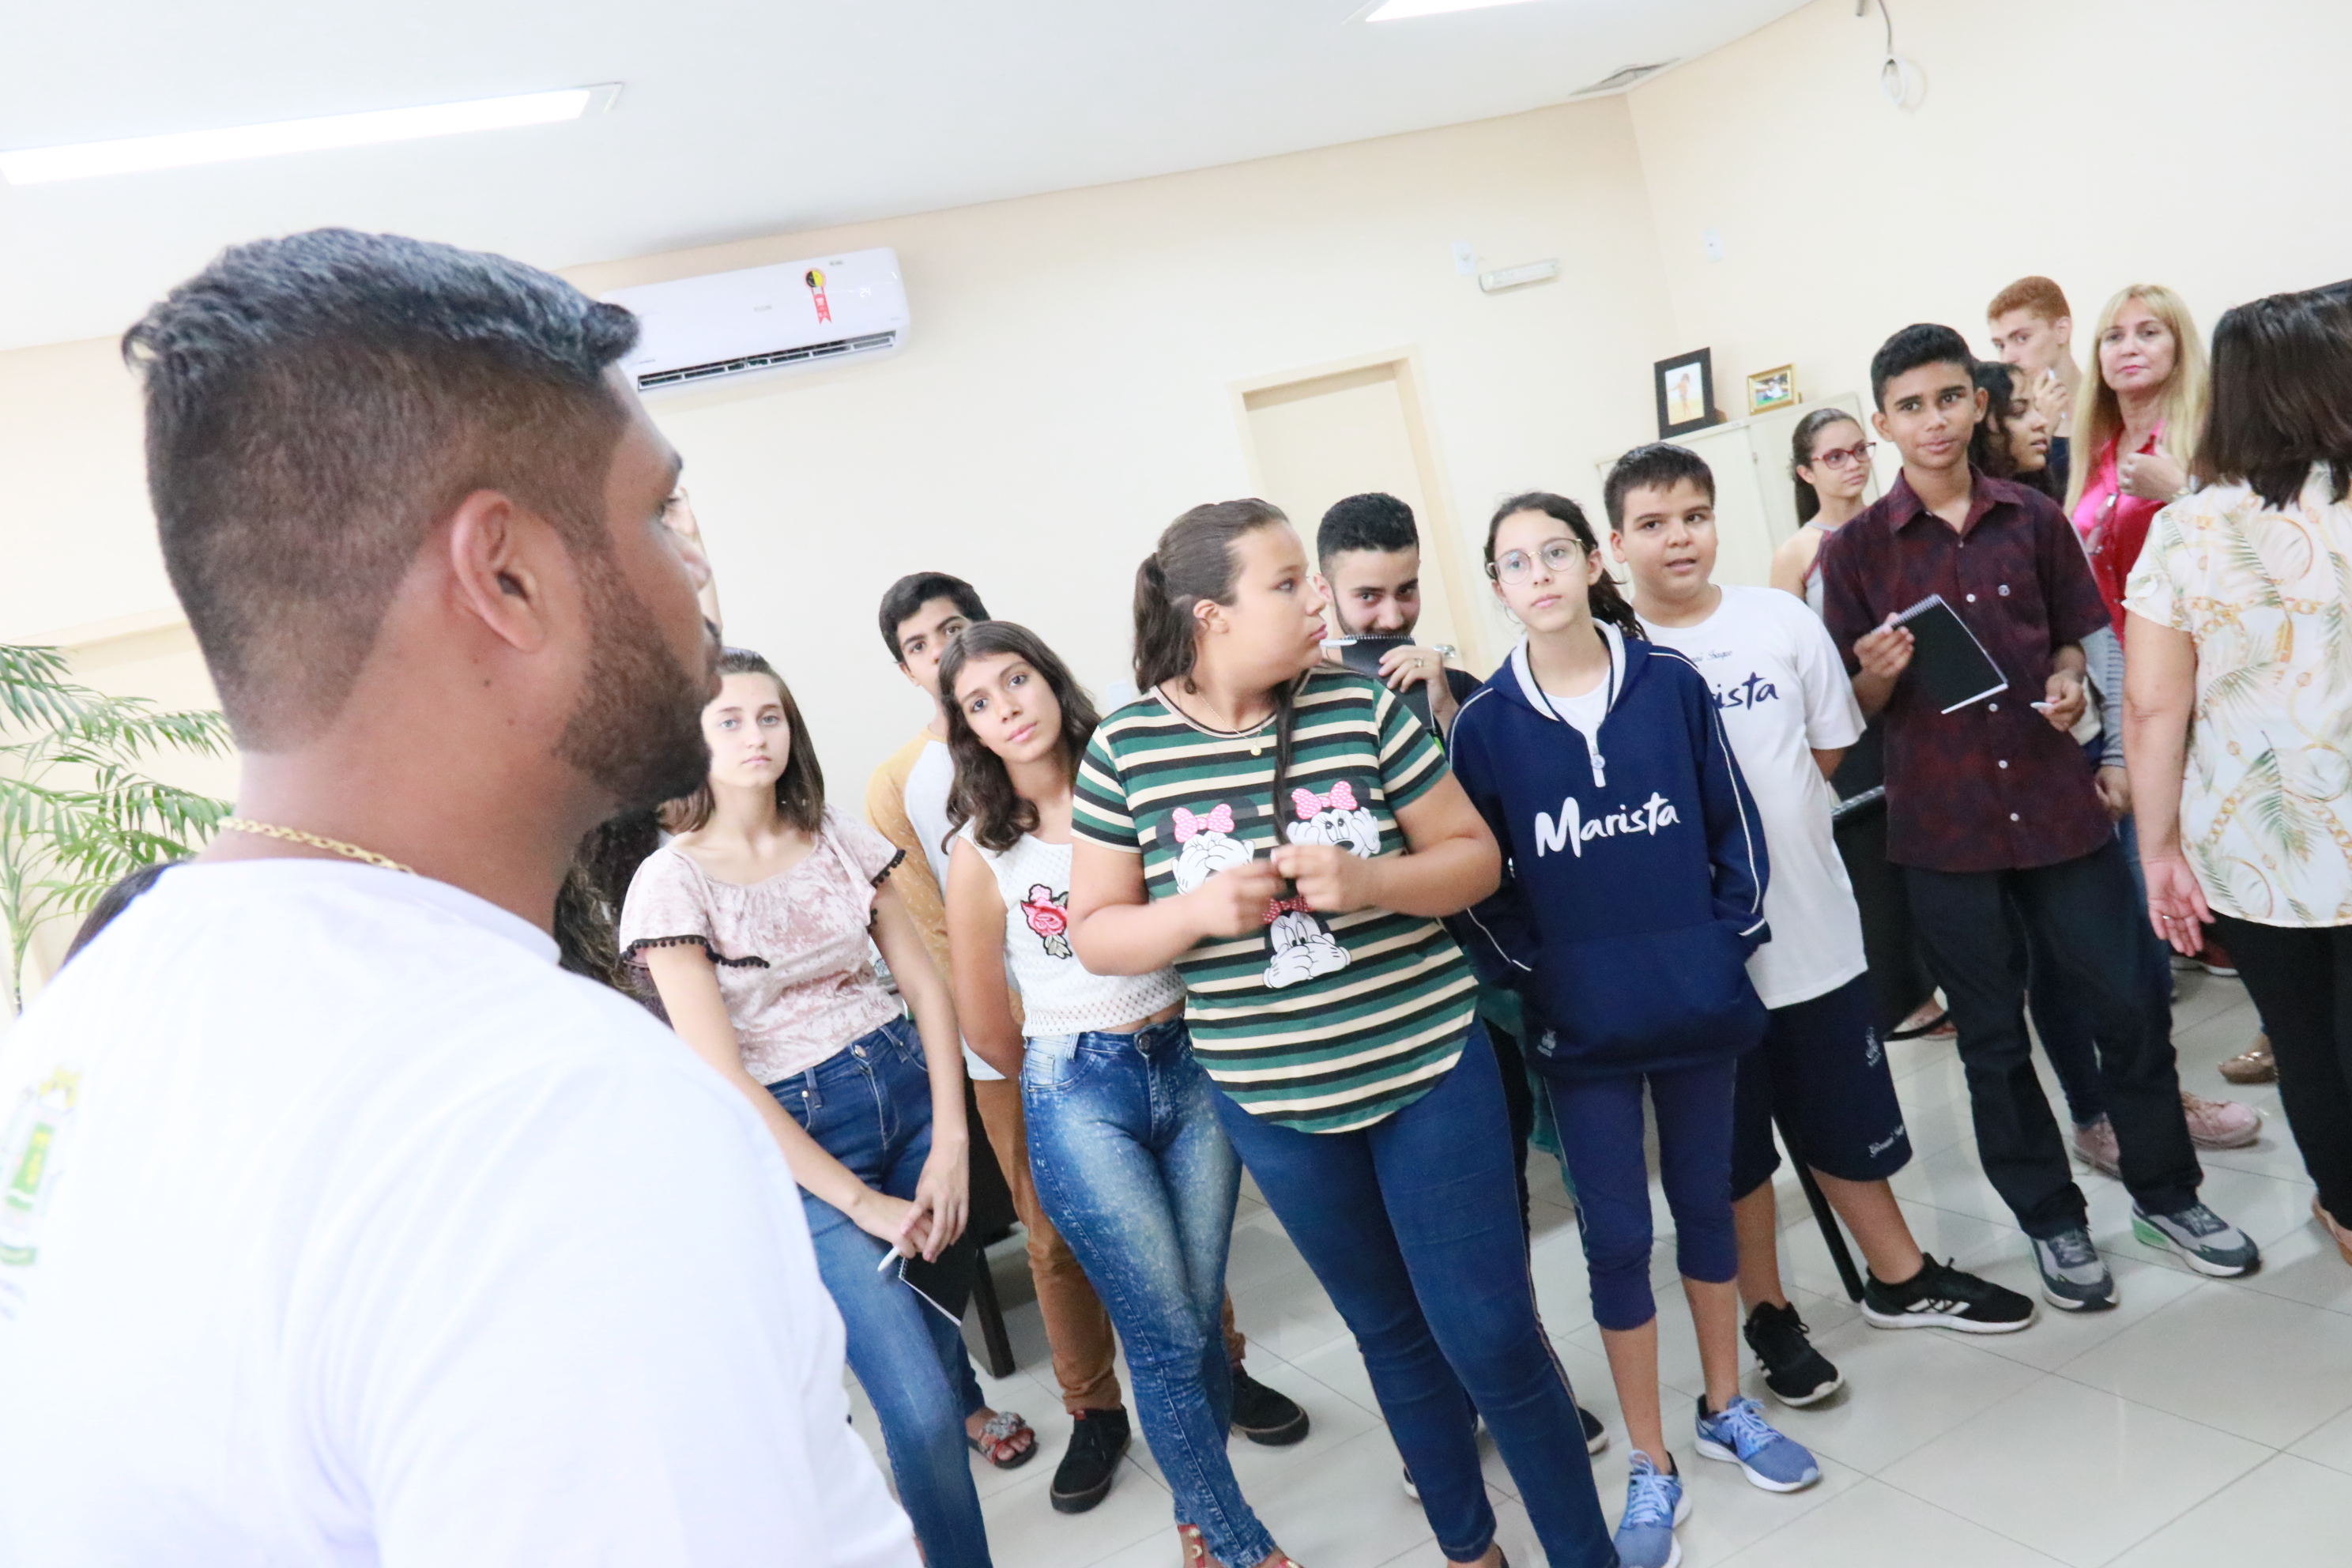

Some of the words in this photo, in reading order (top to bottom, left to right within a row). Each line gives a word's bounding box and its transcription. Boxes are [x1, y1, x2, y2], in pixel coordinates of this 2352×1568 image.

[859, 287, 872, 298] 24
[1712, 671, 1779, 710] ista
[1535, 792, 1681, 858] Marista
